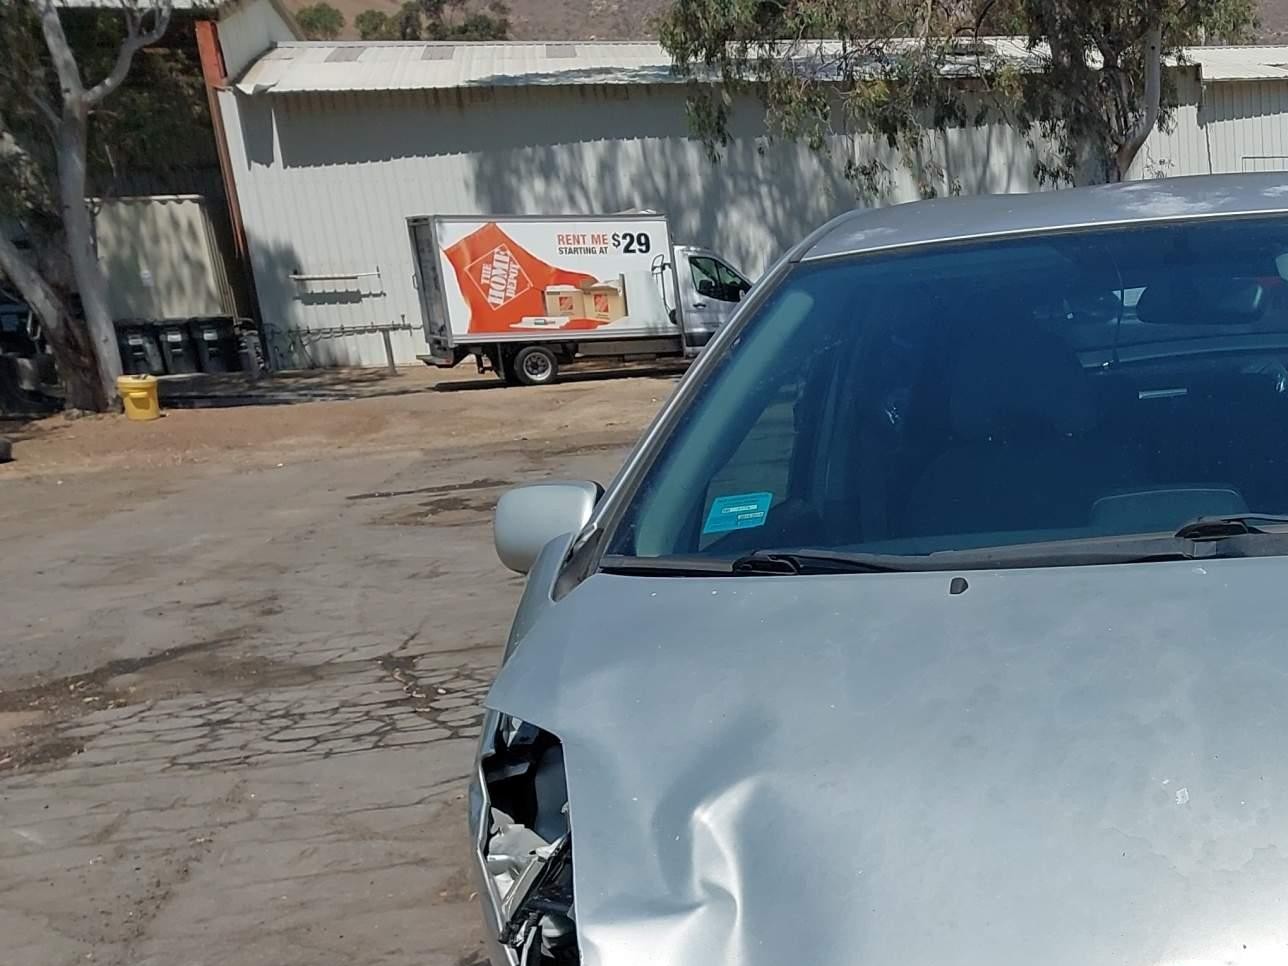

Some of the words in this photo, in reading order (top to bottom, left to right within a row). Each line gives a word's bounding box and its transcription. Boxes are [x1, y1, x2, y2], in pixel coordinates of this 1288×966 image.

[557, 234, 586, 245] RENT
[591, 234, 608, 245] ME
[612, 232, 651, 254] $29
[558, 246, 597, 255] STARTING
[598, 246, 609, 255] AT
[481, 263, 492, 285] THE
[487, 248, 511, 305] HOME
[506, 261, 519, 298] DEPOT
